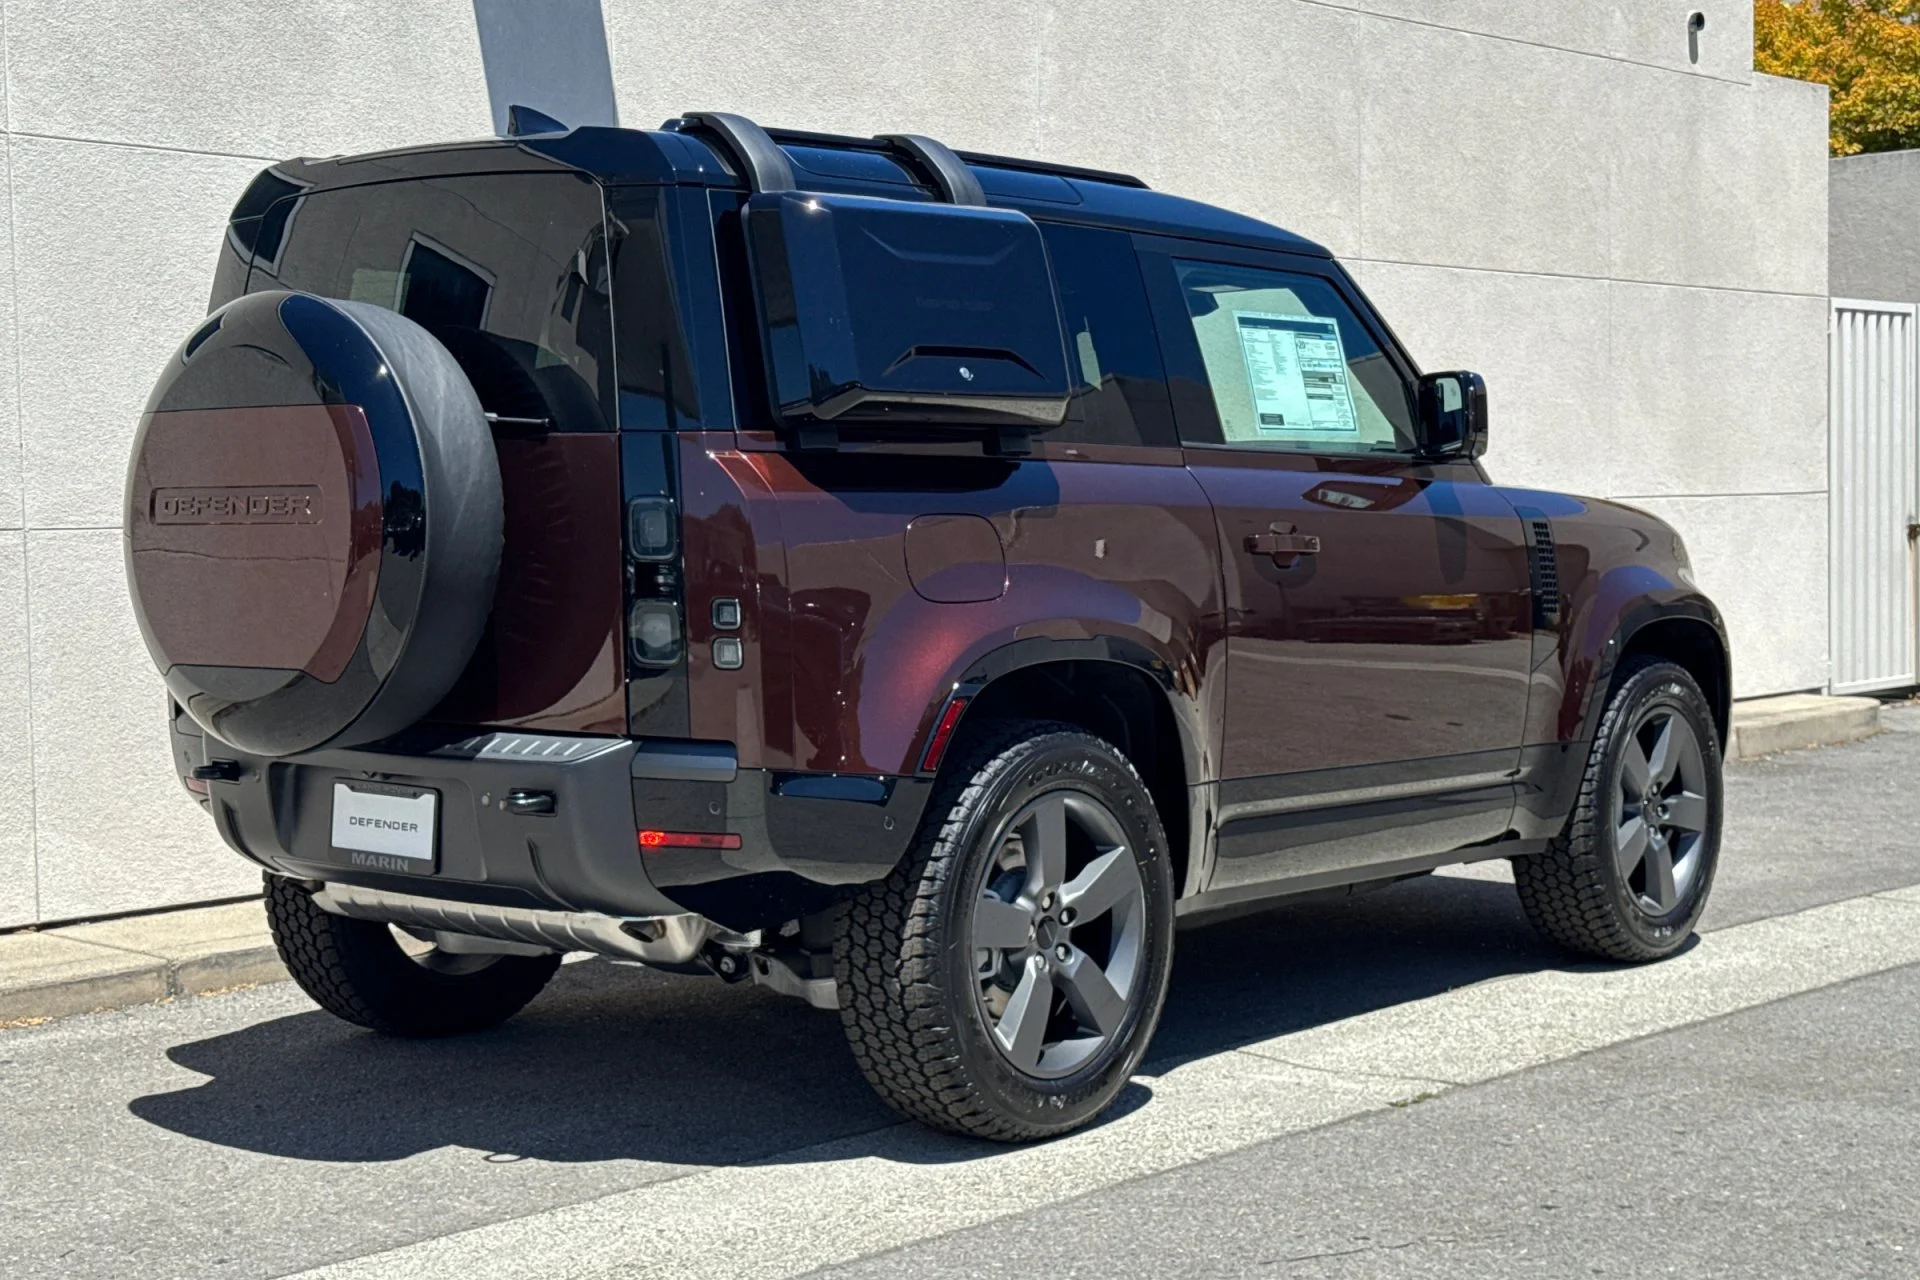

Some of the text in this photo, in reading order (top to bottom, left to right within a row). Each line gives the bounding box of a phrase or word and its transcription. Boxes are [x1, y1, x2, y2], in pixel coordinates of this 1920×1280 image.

[163, 495, 312, 516] DEFENDER
[349, 816, 418, 832] DEFENDER
[351, 852, 409, 872] MARIN
